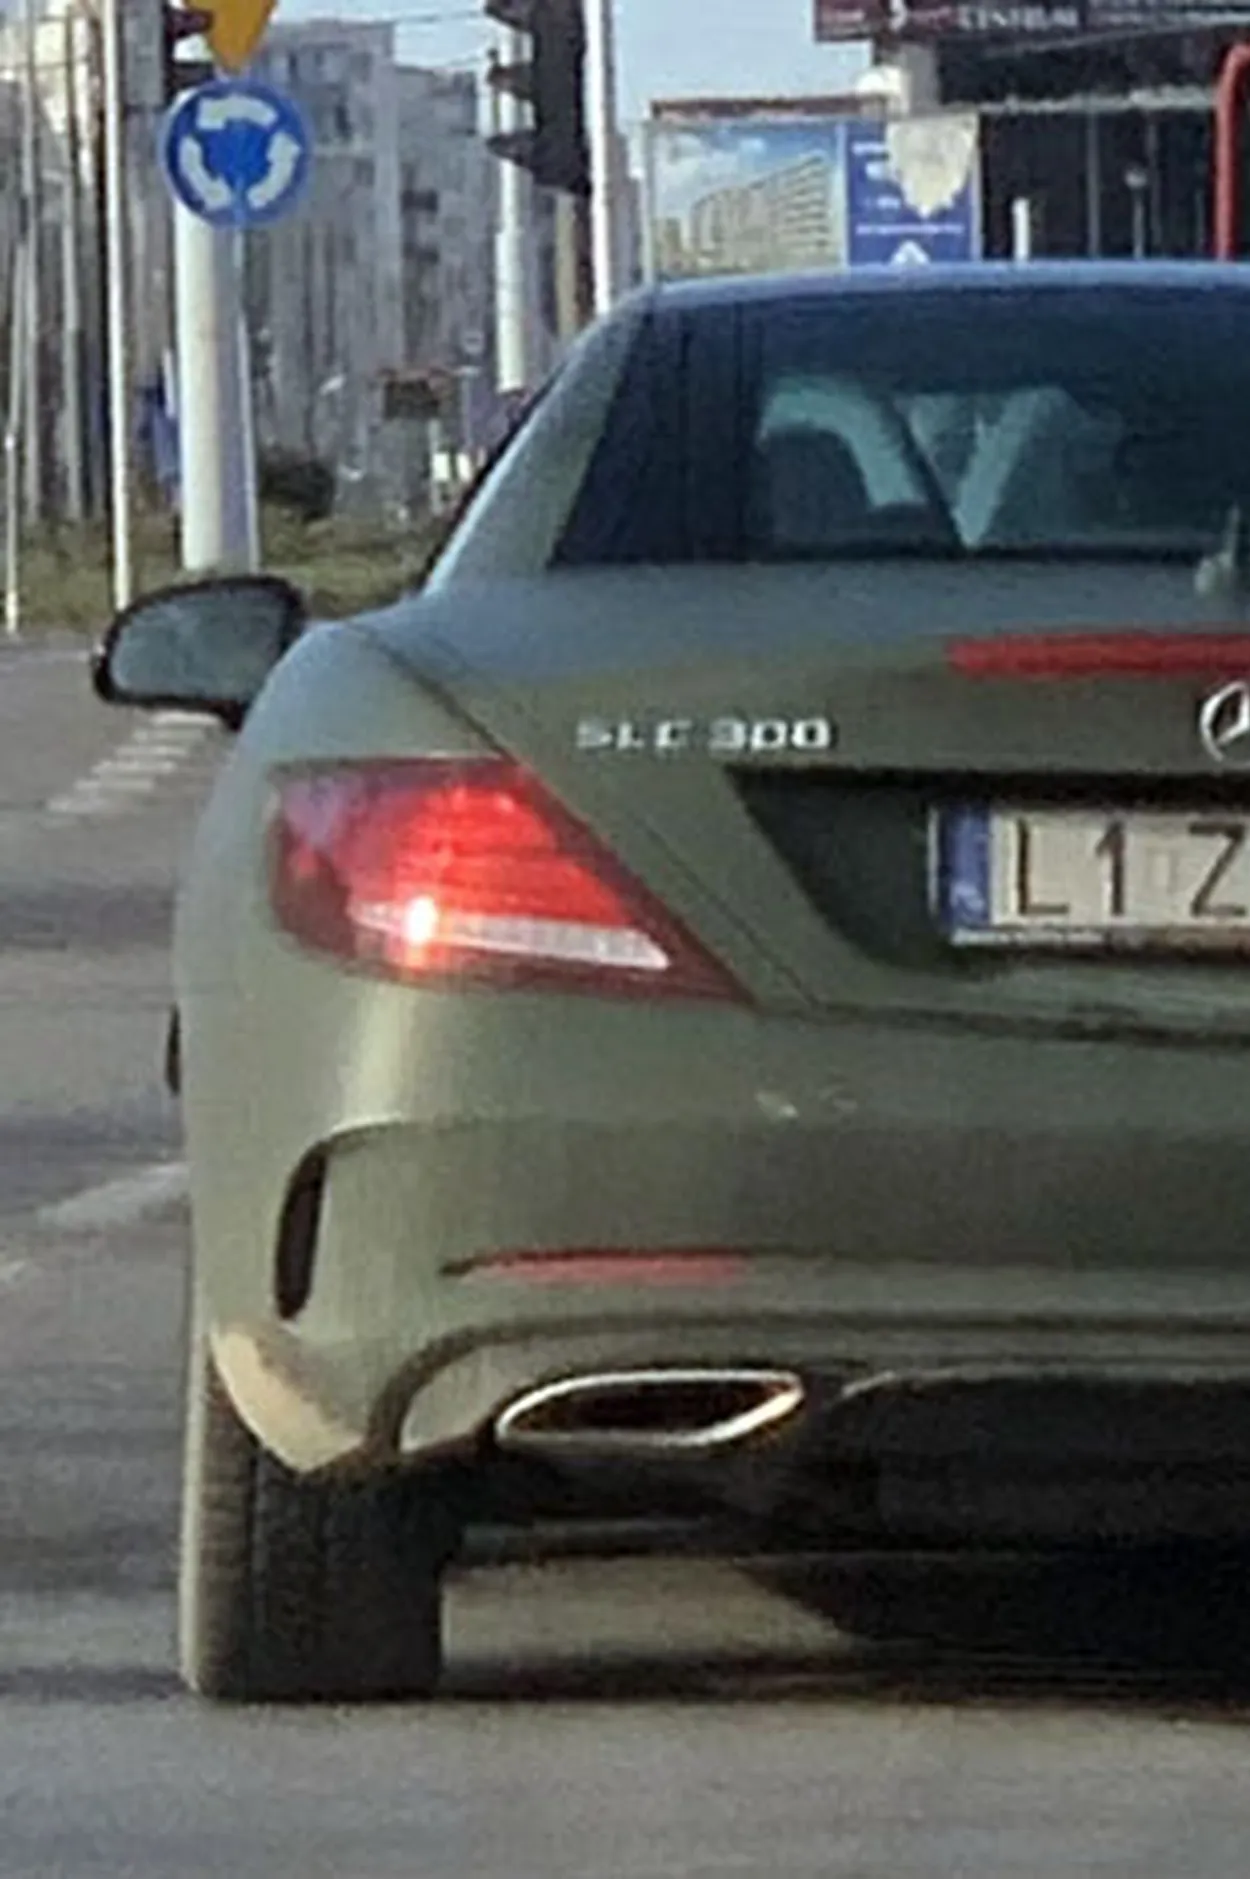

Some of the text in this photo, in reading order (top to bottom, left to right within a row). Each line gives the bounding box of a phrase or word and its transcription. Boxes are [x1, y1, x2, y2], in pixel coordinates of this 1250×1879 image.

[576, 716, 831, 752] SLC 300
[1015, 817, 1127, 917] L1
